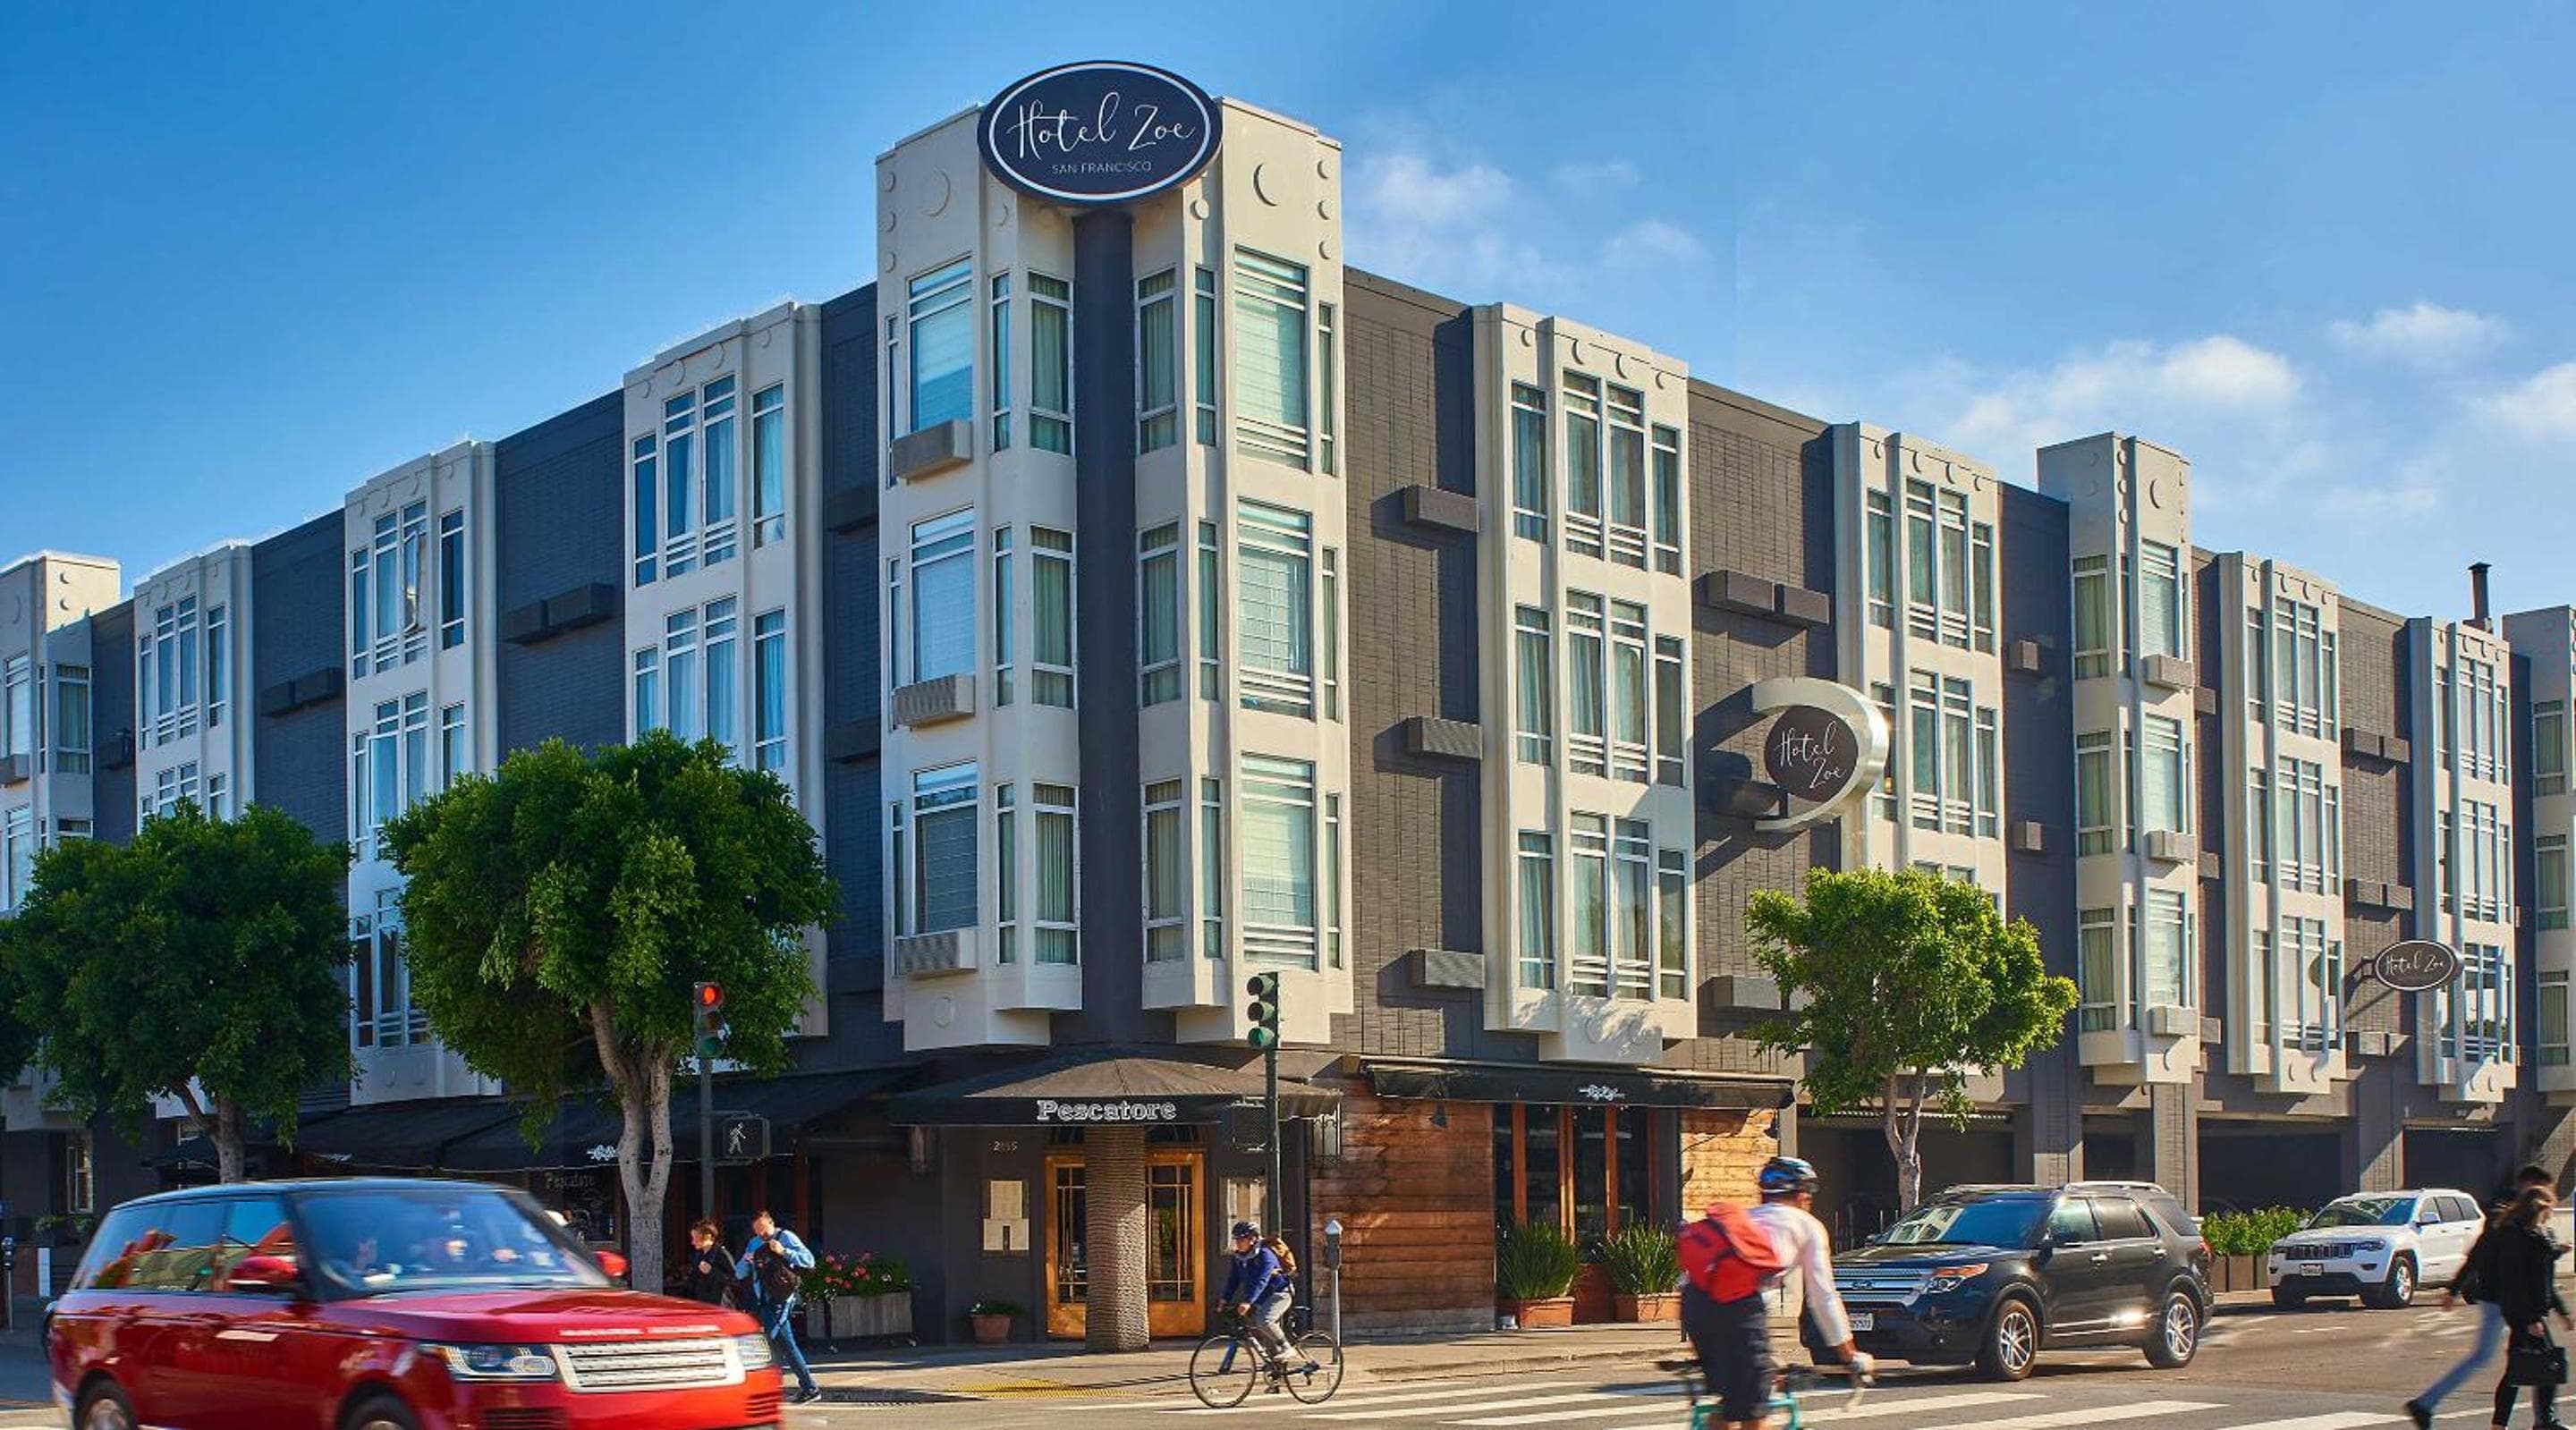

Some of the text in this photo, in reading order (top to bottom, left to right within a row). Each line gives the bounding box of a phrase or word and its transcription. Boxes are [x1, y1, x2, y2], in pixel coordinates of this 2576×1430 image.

[1006, 92, 1196, 161] Hotel Zoe
[1052, 164, 1077, 174] SAN
[1774, 719, 1838, 768] Hotel
[1809, 757, 1847, 790] Zoe
[1037, 1099, 1177, 1121] Pescatore
